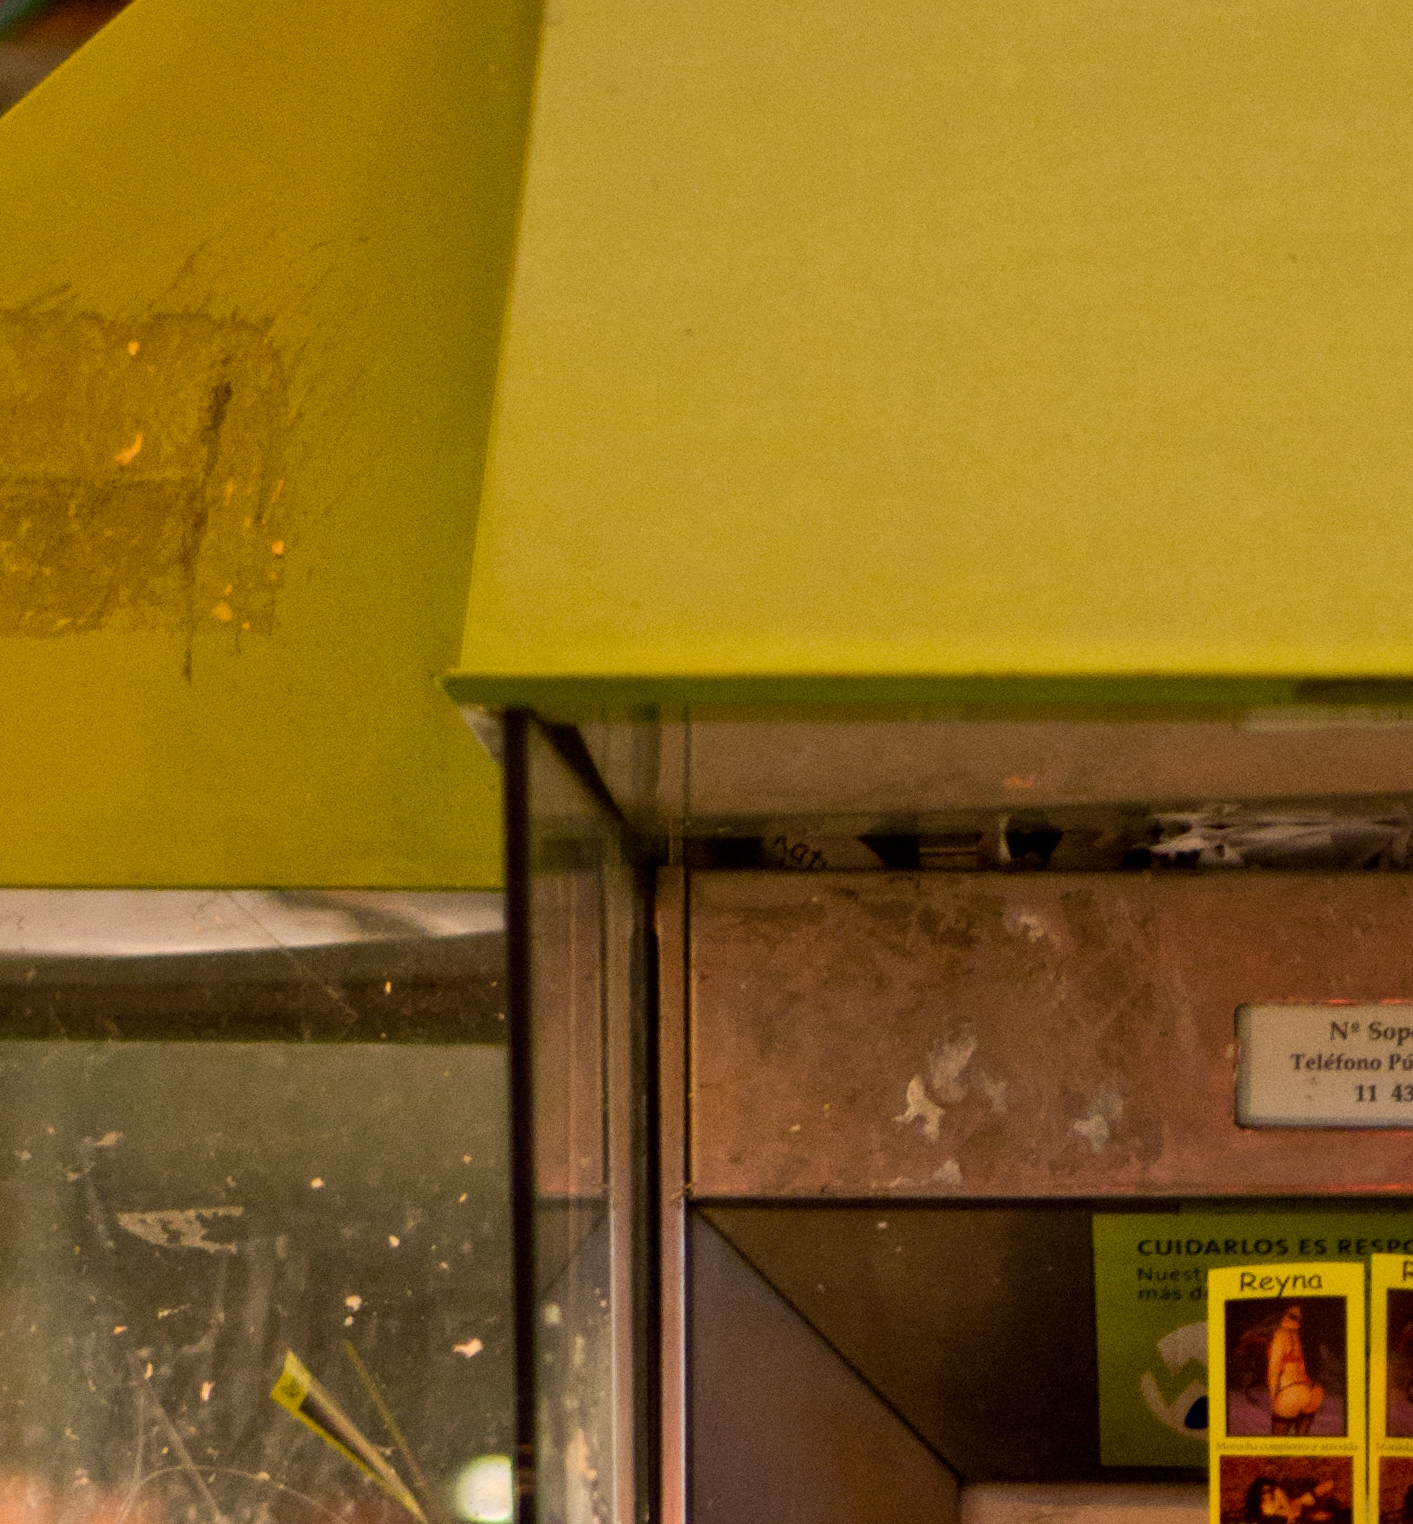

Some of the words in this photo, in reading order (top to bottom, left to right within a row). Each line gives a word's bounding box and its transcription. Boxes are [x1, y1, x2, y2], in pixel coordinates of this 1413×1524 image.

[1290, 1052, 1381, 1071] Teléfono
[1355, 1085, 1377, 1101] 11
[1138, 1239, 1288, 1256] CUIDARLOS
[1299, 1239, 1328, 1255] ES
[1137, 1267, 1208, 1282] Nuest
[1239, 1271, 1323, 1298] Reyna
